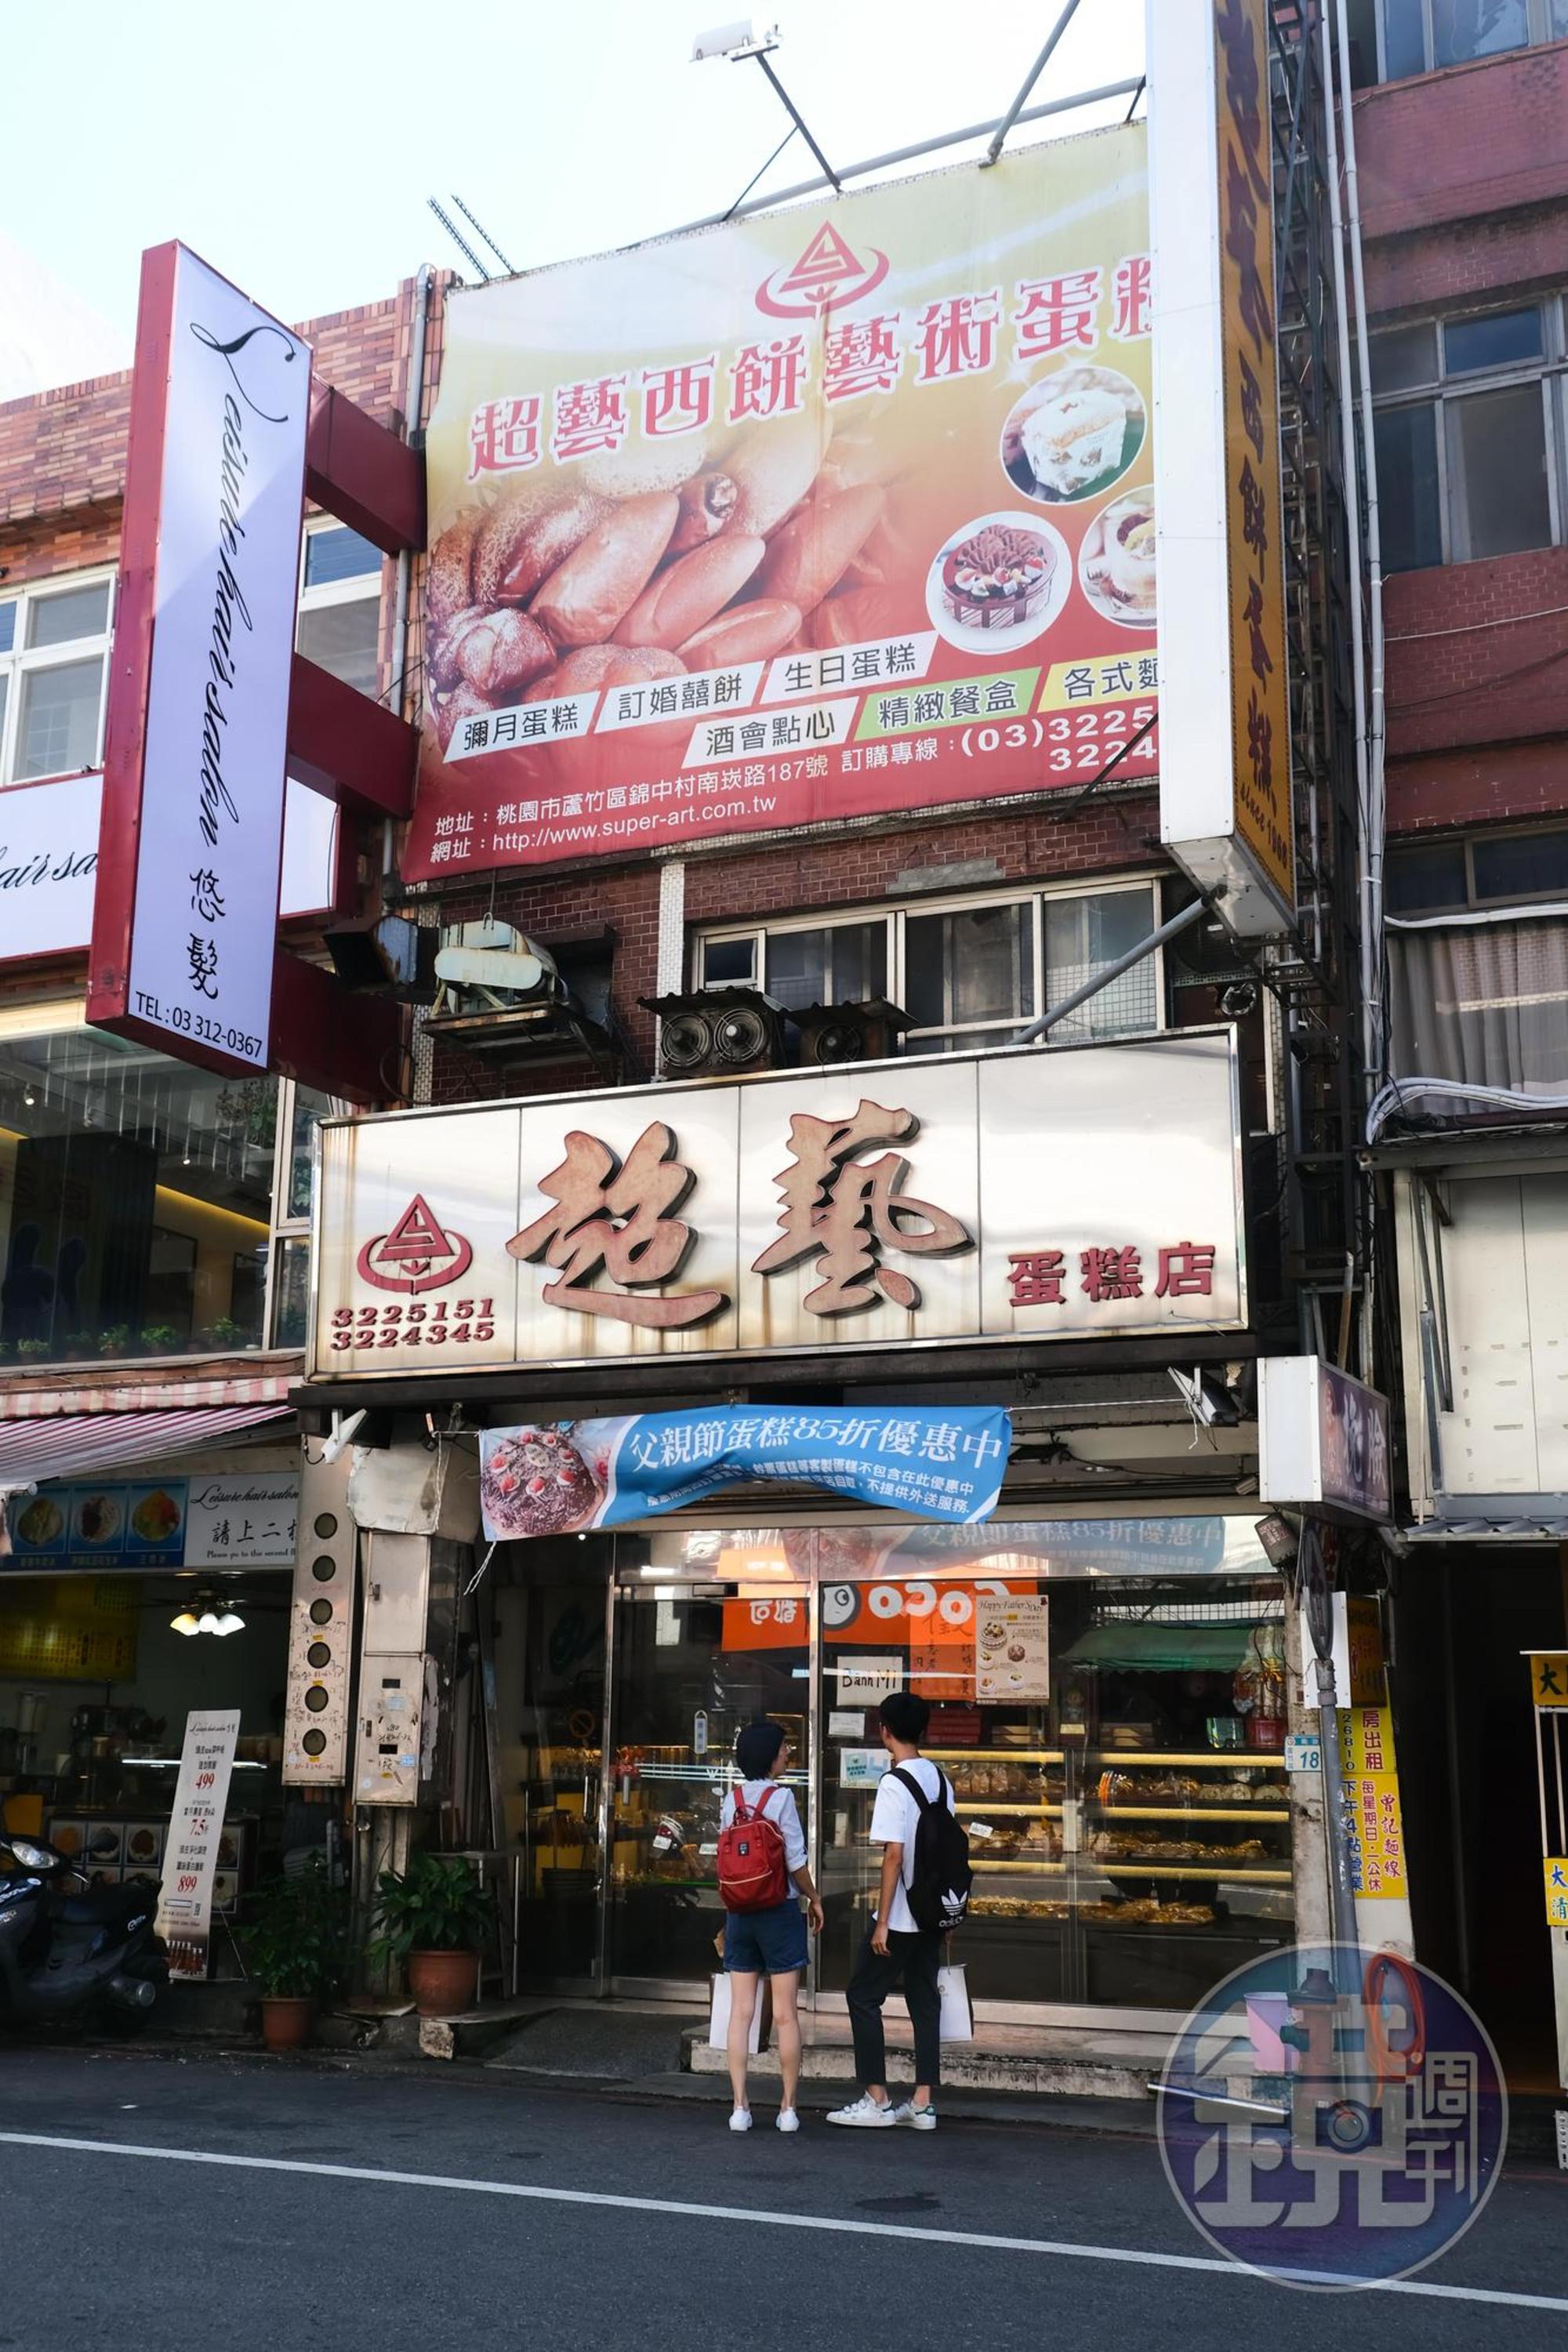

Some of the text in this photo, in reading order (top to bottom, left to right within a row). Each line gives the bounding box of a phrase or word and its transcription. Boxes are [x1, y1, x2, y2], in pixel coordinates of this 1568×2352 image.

[785, 642, 916, 692] 生日蛋糕
[618, 672, 742, 720] 訂婚囍餅
[879, 681, 1017, 730] 精緻餐盒
[463, 702, 579, 750] 彌月蛋糕
[706, 710, 836, 757] 酒會點心
[0, 846, 50, 888] air
[187, 868, 226, 1000] 悠髮
[194, 1014, 263, 1058] 312-0367
[506, 1098, 975, 1331] 超藝
[1007, 1241, 1216, 1307] 蛋糕店
[330, 1321, 495, 1351] 3224345
[331, 1298, 495, 1328] 3225151
[629, 1416, 1003, 1472] 父親節蛋糕85折優惠中
[1539, 1663, 1568, 1696] 大
[1341, 1707, 1355, 1770] 26810
[1363, 1710, 1384, 1770] 房出租
[177, 1875, 198, 1893] 899
